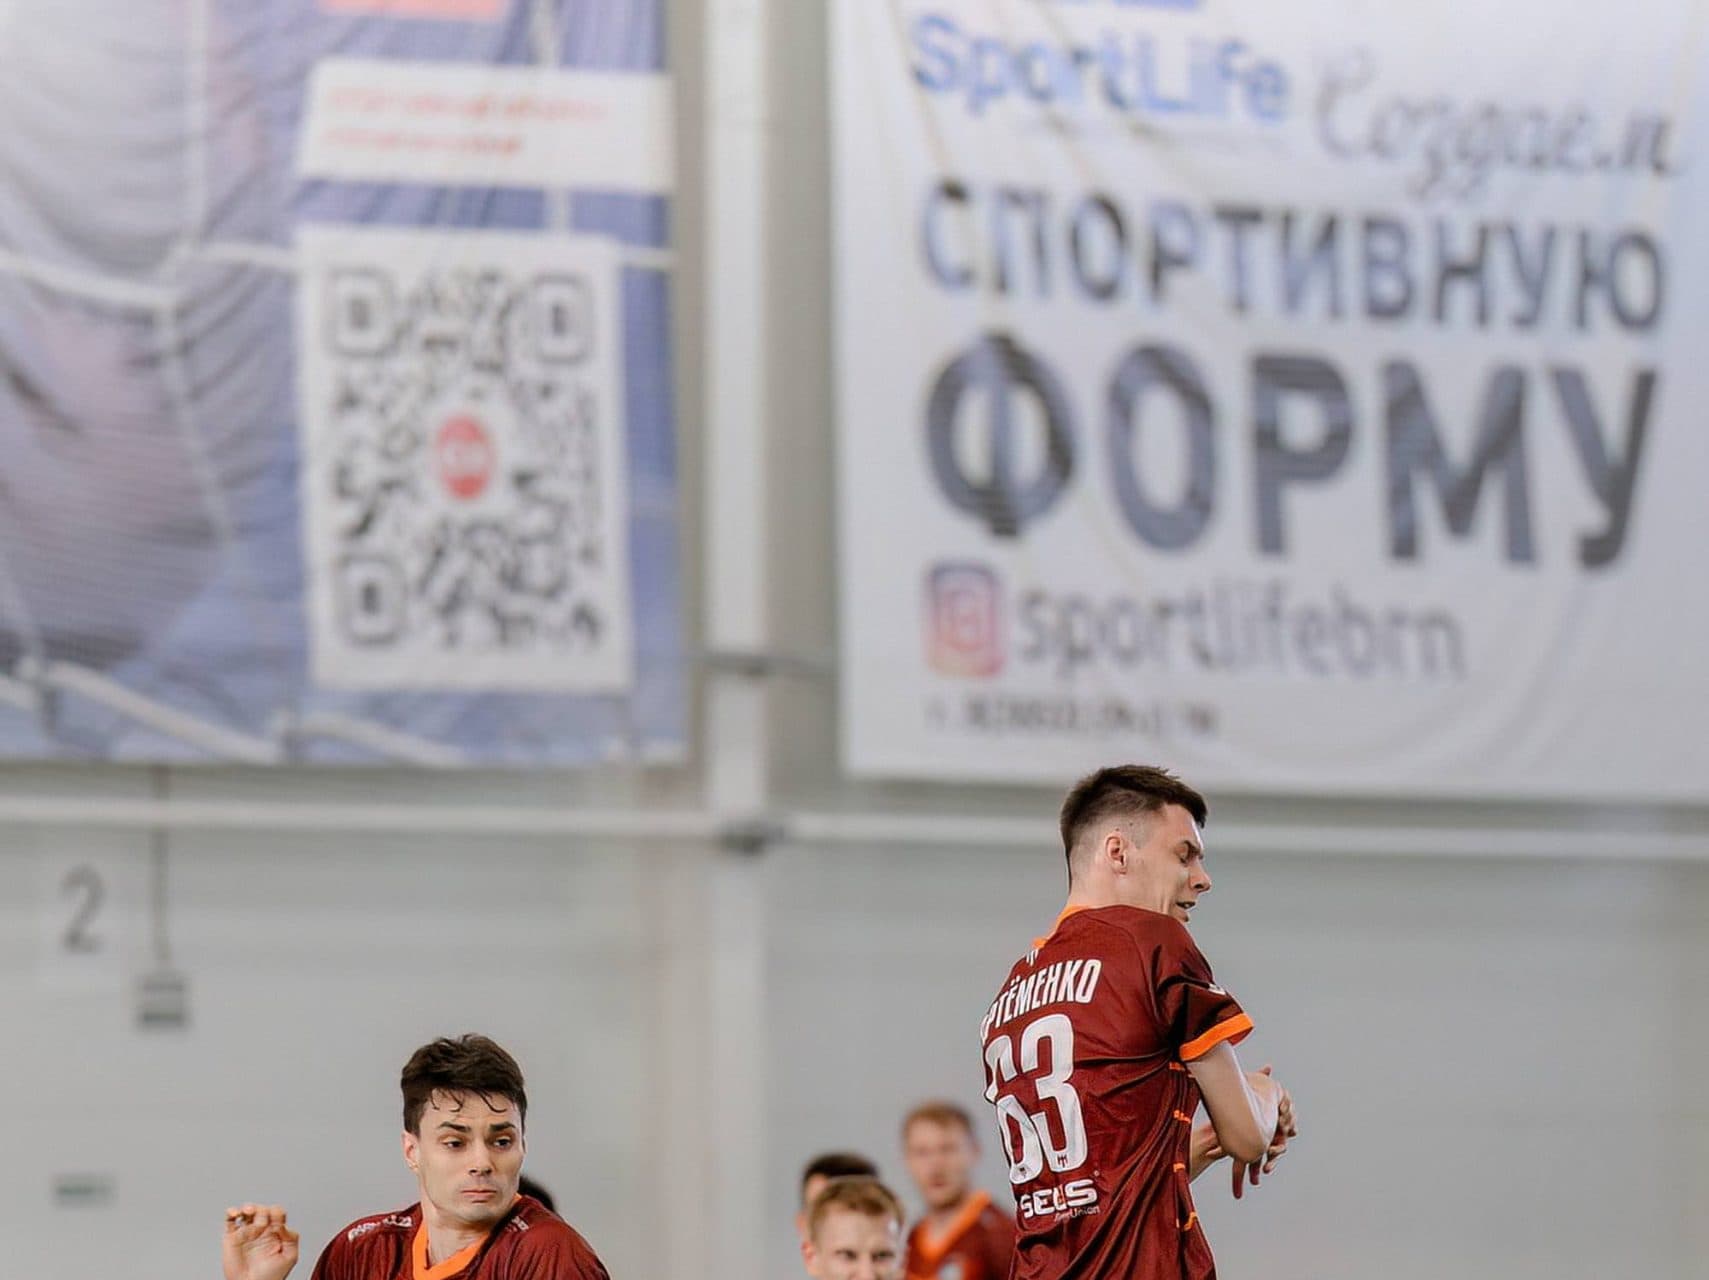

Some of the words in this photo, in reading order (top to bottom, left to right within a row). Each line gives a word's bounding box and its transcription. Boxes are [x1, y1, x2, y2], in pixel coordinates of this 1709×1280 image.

[912, 14, 1288, 121] SportLife
[920, 178, 1667, 335] СПОРТИВНУЮ
[926, 332, 1658, 572] ФОРМУ
[60, 865, 107, 954] 2
[984, 1013, 1088, 1185] 63
